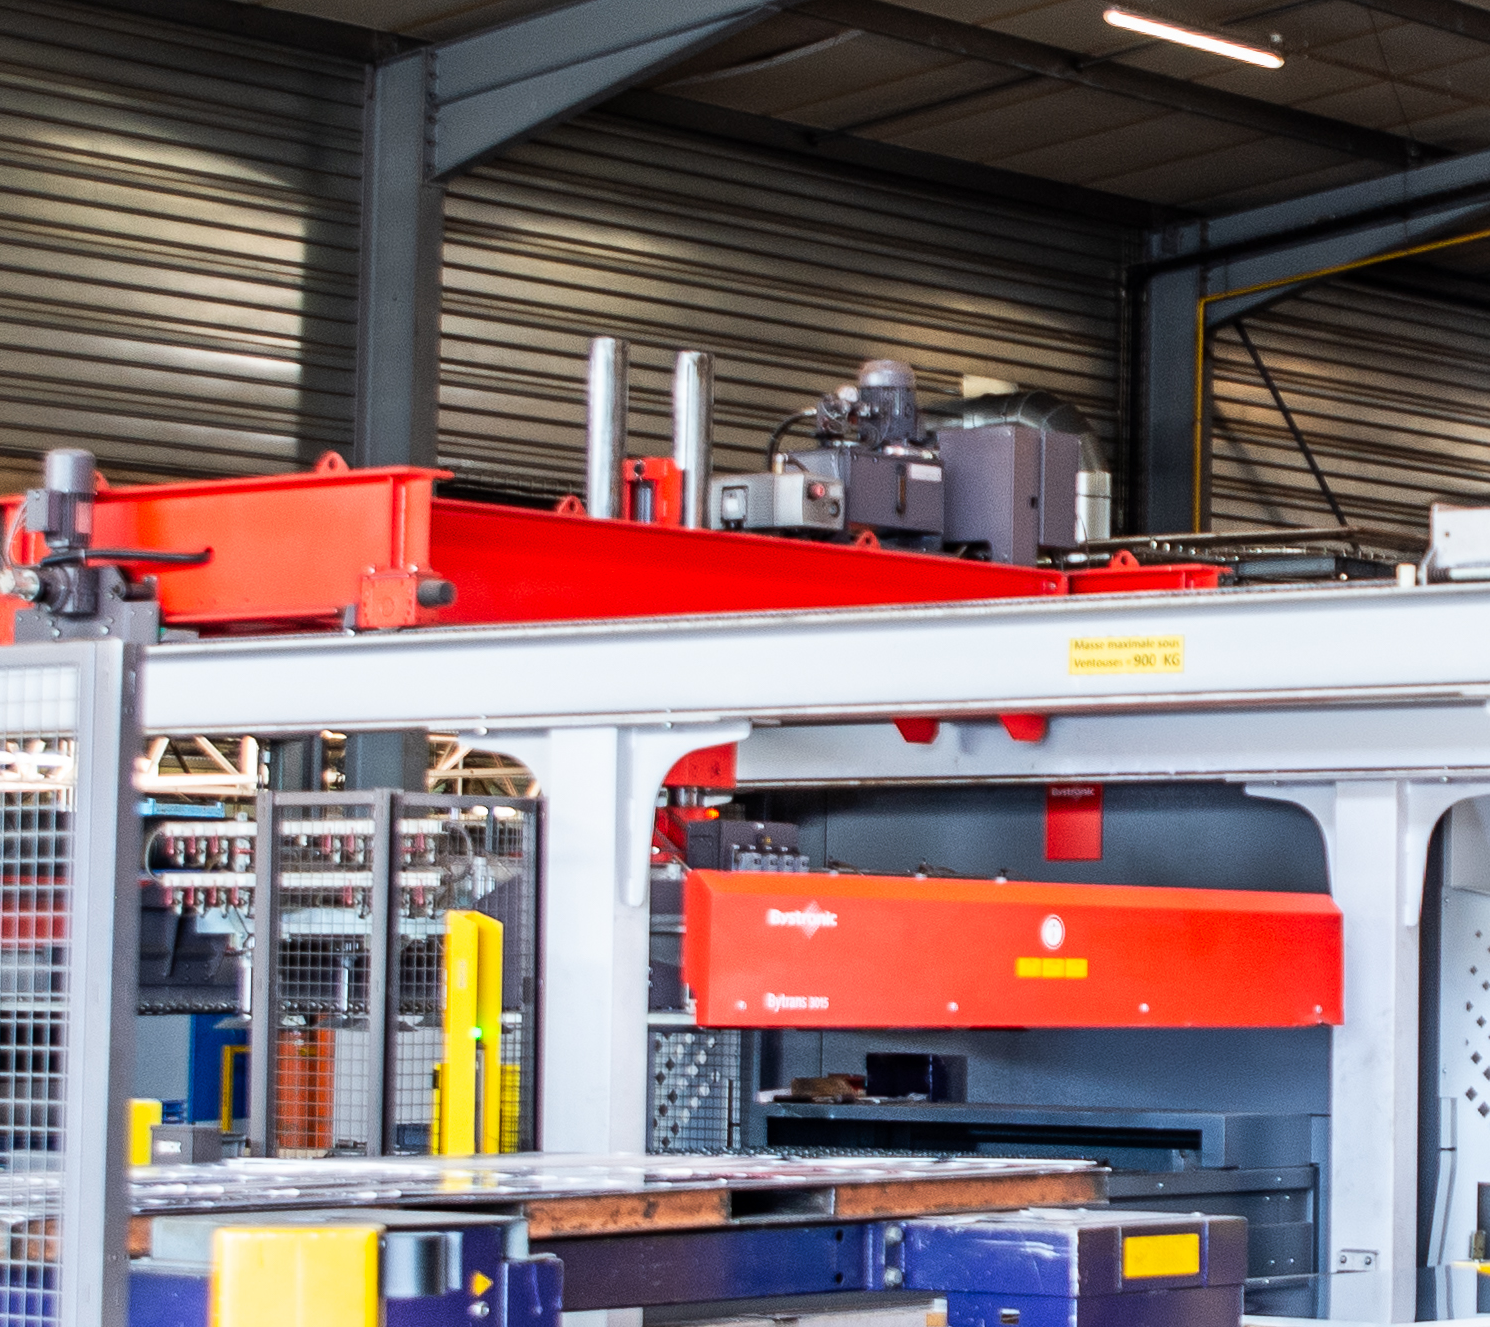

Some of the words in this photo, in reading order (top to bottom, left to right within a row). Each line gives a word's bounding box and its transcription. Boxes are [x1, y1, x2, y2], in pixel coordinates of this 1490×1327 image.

[1074, 639, 1105, 651] Masse
[1107, 638, 1155, 650] maximale
[1157, 639, 1180, 649] sous
[1074, 658, 1123, 668] Ventouses
[1133, 653, 1157, 667] 900
[1163, 652, 1180, 667] KG
[768, 908, 838, 928] Bystronic
[766, 992, 807, 1013] Bytrans
[809, 996, 830, 1009] 3015
